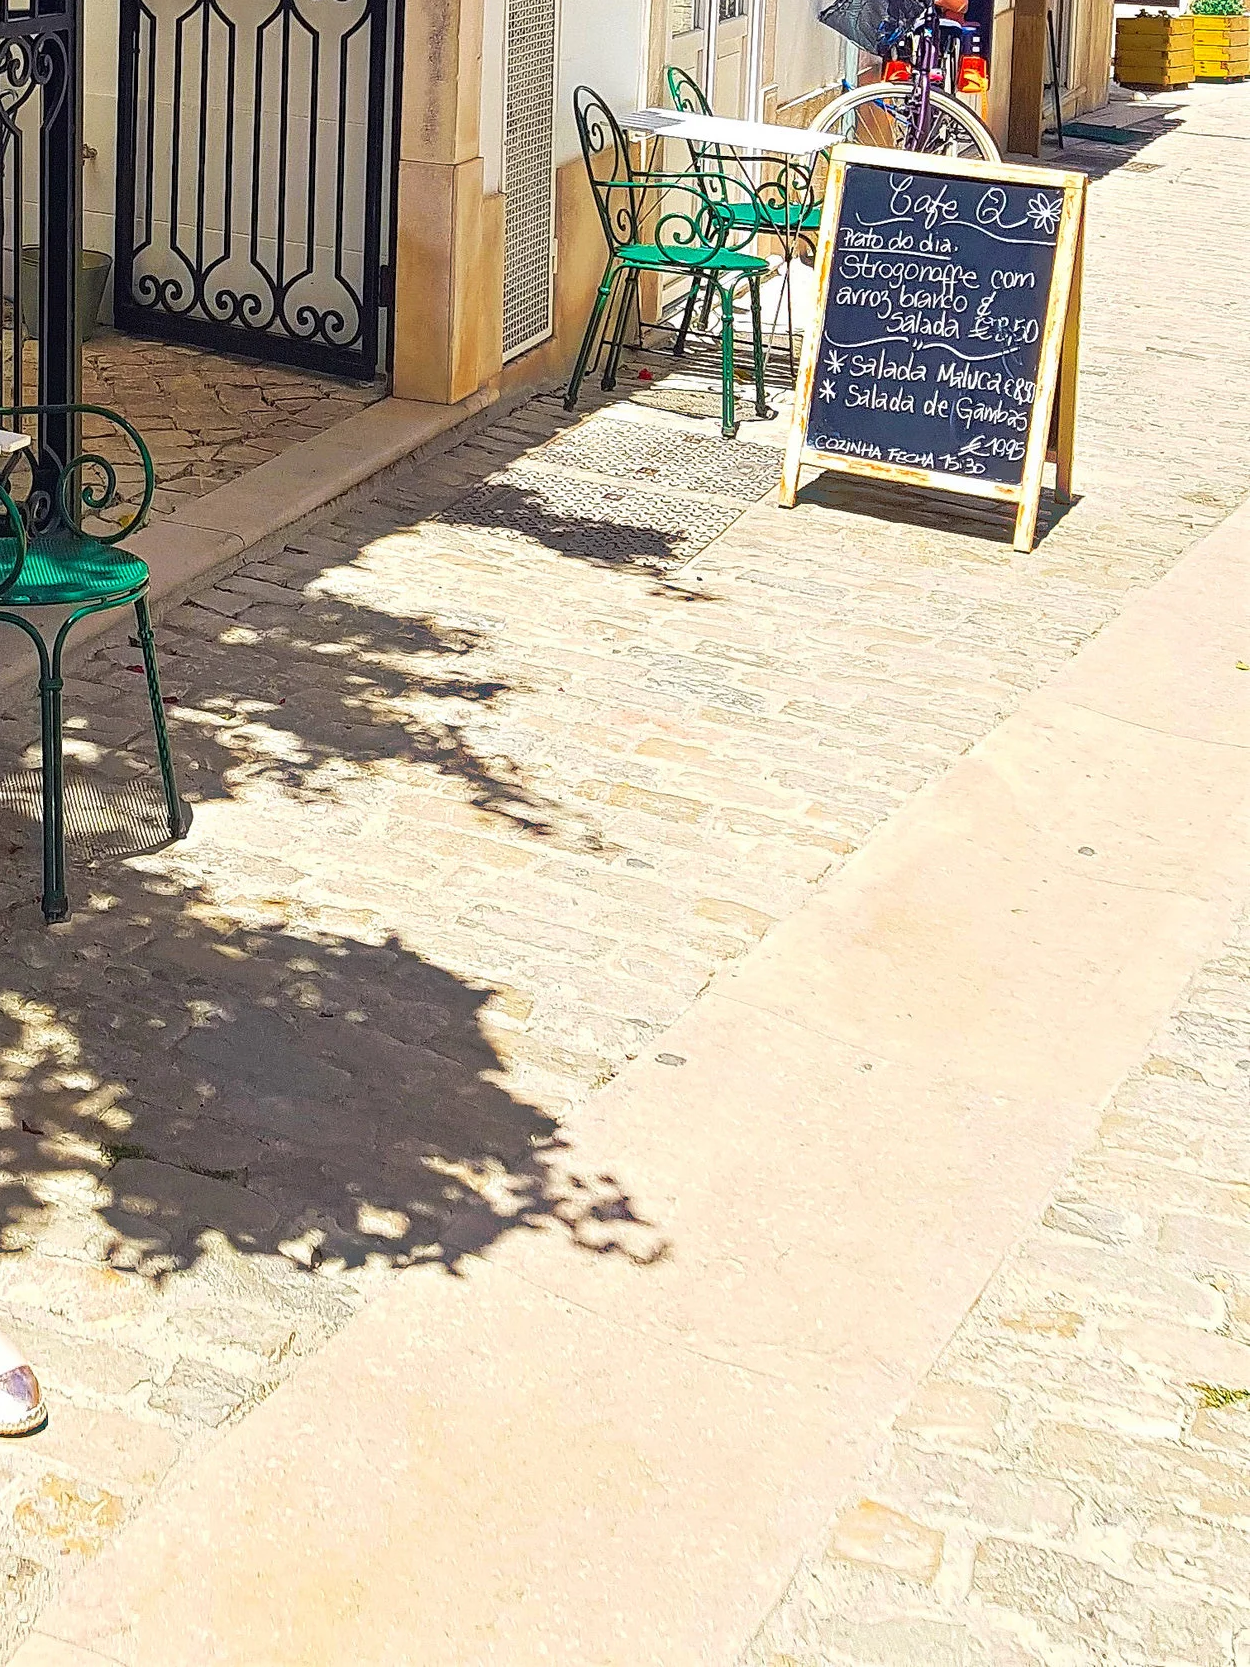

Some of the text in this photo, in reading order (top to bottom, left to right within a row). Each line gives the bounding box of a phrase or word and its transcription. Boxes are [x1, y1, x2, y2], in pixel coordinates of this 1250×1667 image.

[889, 173, 960, 230] Cafe
[840, 227, 884, 249] Prato
[888, 231, 914, 250] do
[991, 270, 1036, 290] com
[836, 286, 893, 319] arroz
[899, 284, 968, 313] branco
[850, 348, 926, 382] Salada
[845, 383, 1028, 432] Salada de Gambas
[814, 434, 882, 460] COZINHA
[887, 446, 936, 469] FECHA
